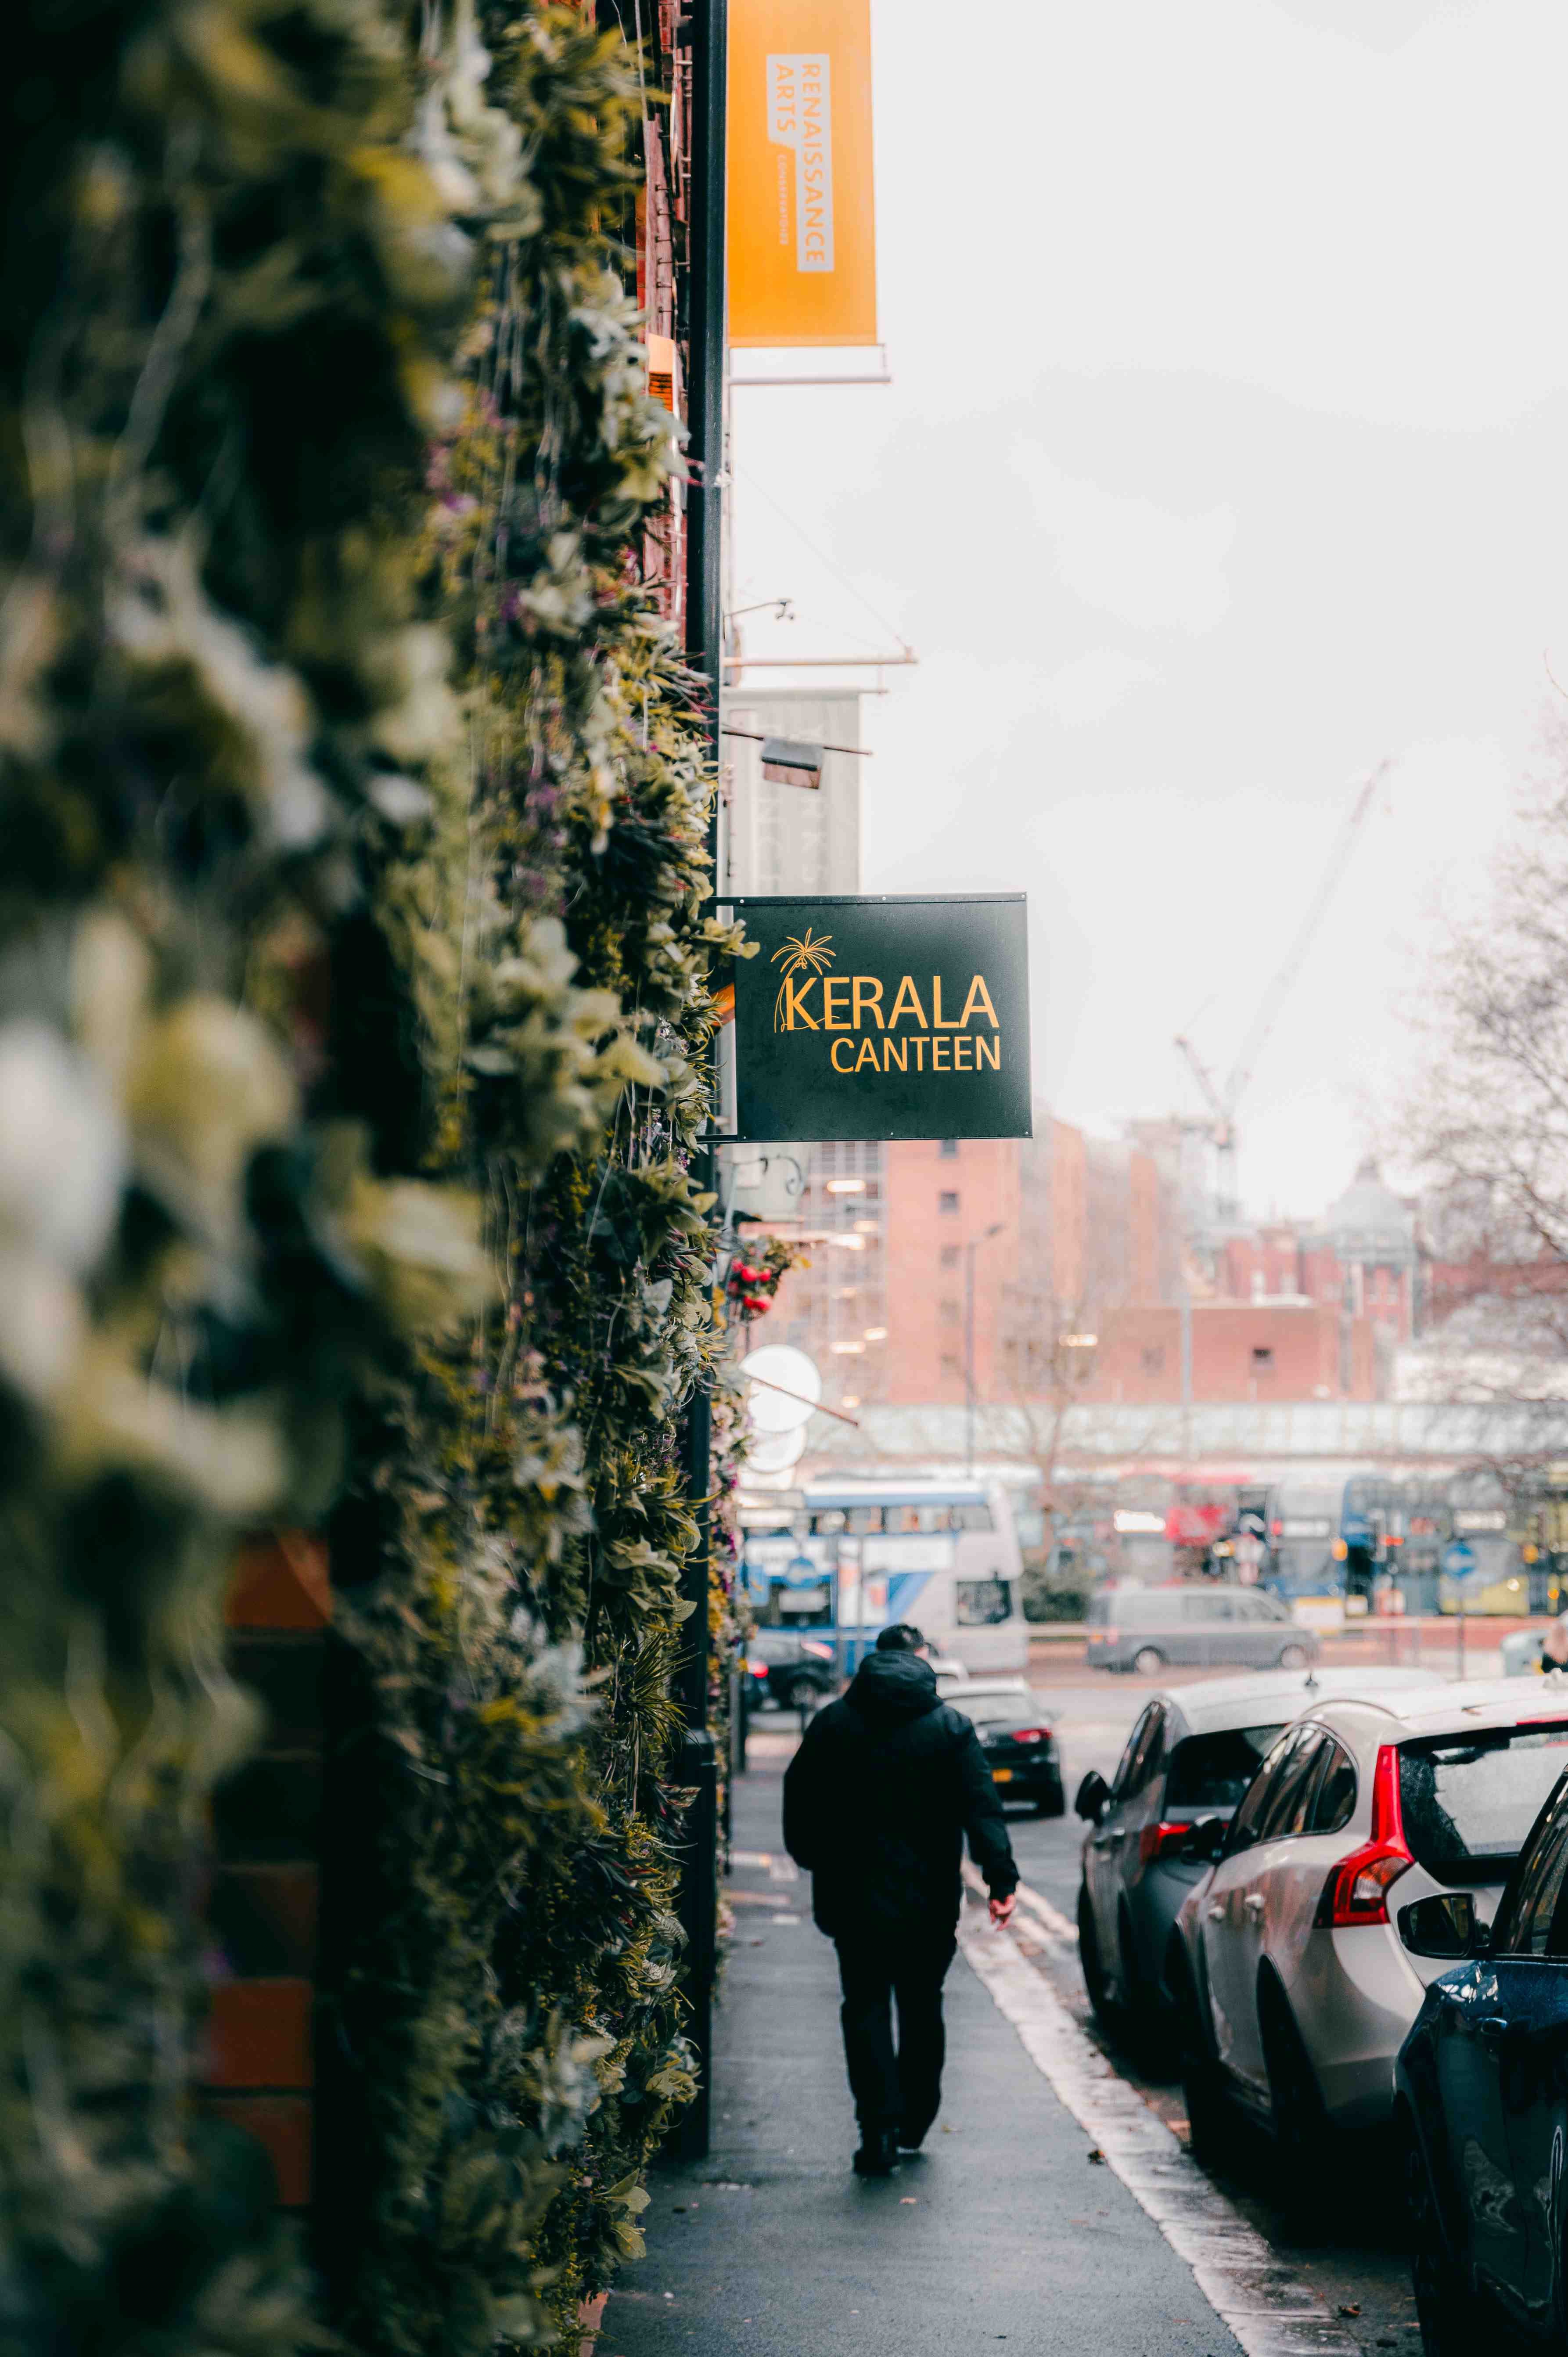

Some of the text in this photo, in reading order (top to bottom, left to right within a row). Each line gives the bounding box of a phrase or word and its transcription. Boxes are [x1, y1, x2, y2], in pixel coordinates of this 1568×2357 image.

[775, 63, 796, 133] ARTS
[801, 63, 826, 263] RENAISSANCE
[785, 975, 1000, 1030] KERALA
[831, 1036, 1000, 1073] CANTEEN
